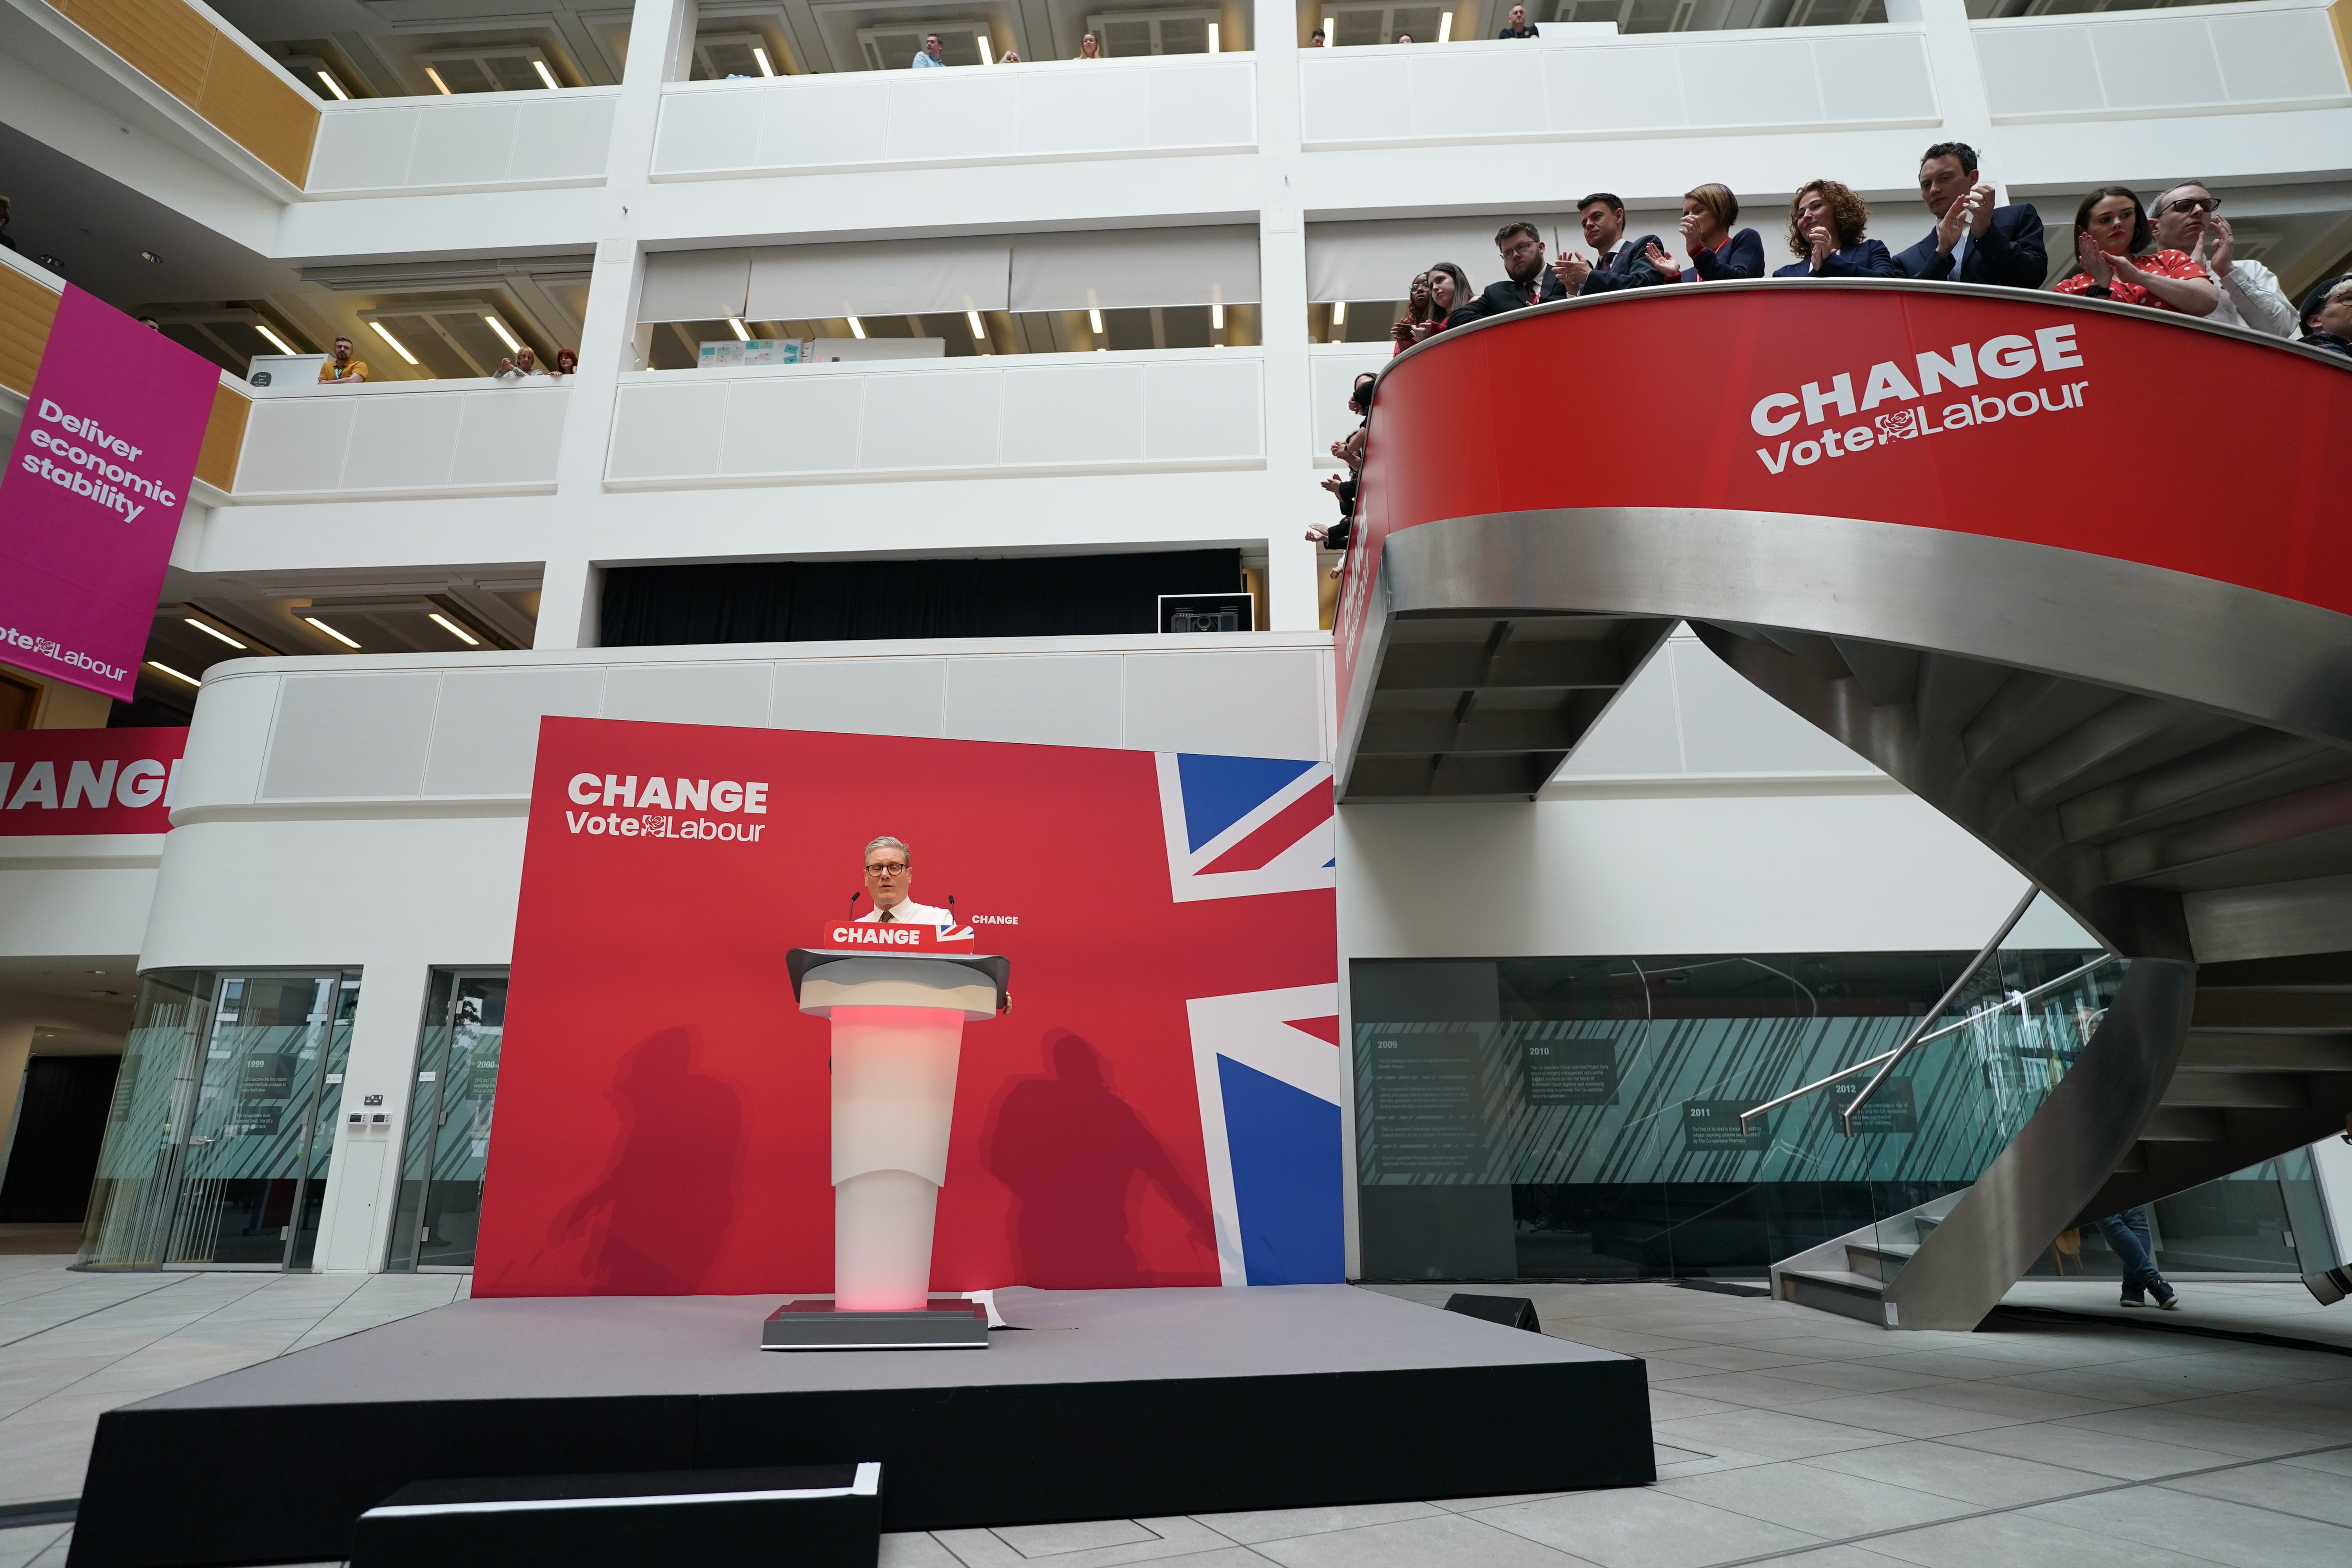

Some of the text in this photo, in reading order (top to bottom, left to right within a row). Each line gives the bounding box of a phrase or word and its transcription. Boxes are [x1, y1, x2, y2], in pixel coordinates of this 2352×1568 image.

[1750, 323, 2084, 437] CHANGE
[38, 398, 142, 462] Deliver
[1756, 381, 2089, 475] Vote Labour
[22, 454, 145, 523] stability
[31, 429, 176, 507] economic
[1345, 491, 1368, 637] CHANGE
[53, 644, 127, 681] Labour
[568, 773, 769, 814] CHANGE
[565, 811, 765, 842] Vote Labour
[833, 927, 920, 945] CHANGE
[972, 915, 1018, 925] CHANGE
[1836, 1085, 1856, 1093] 2012
[1690, 1108, 1710, 1116] 2011
